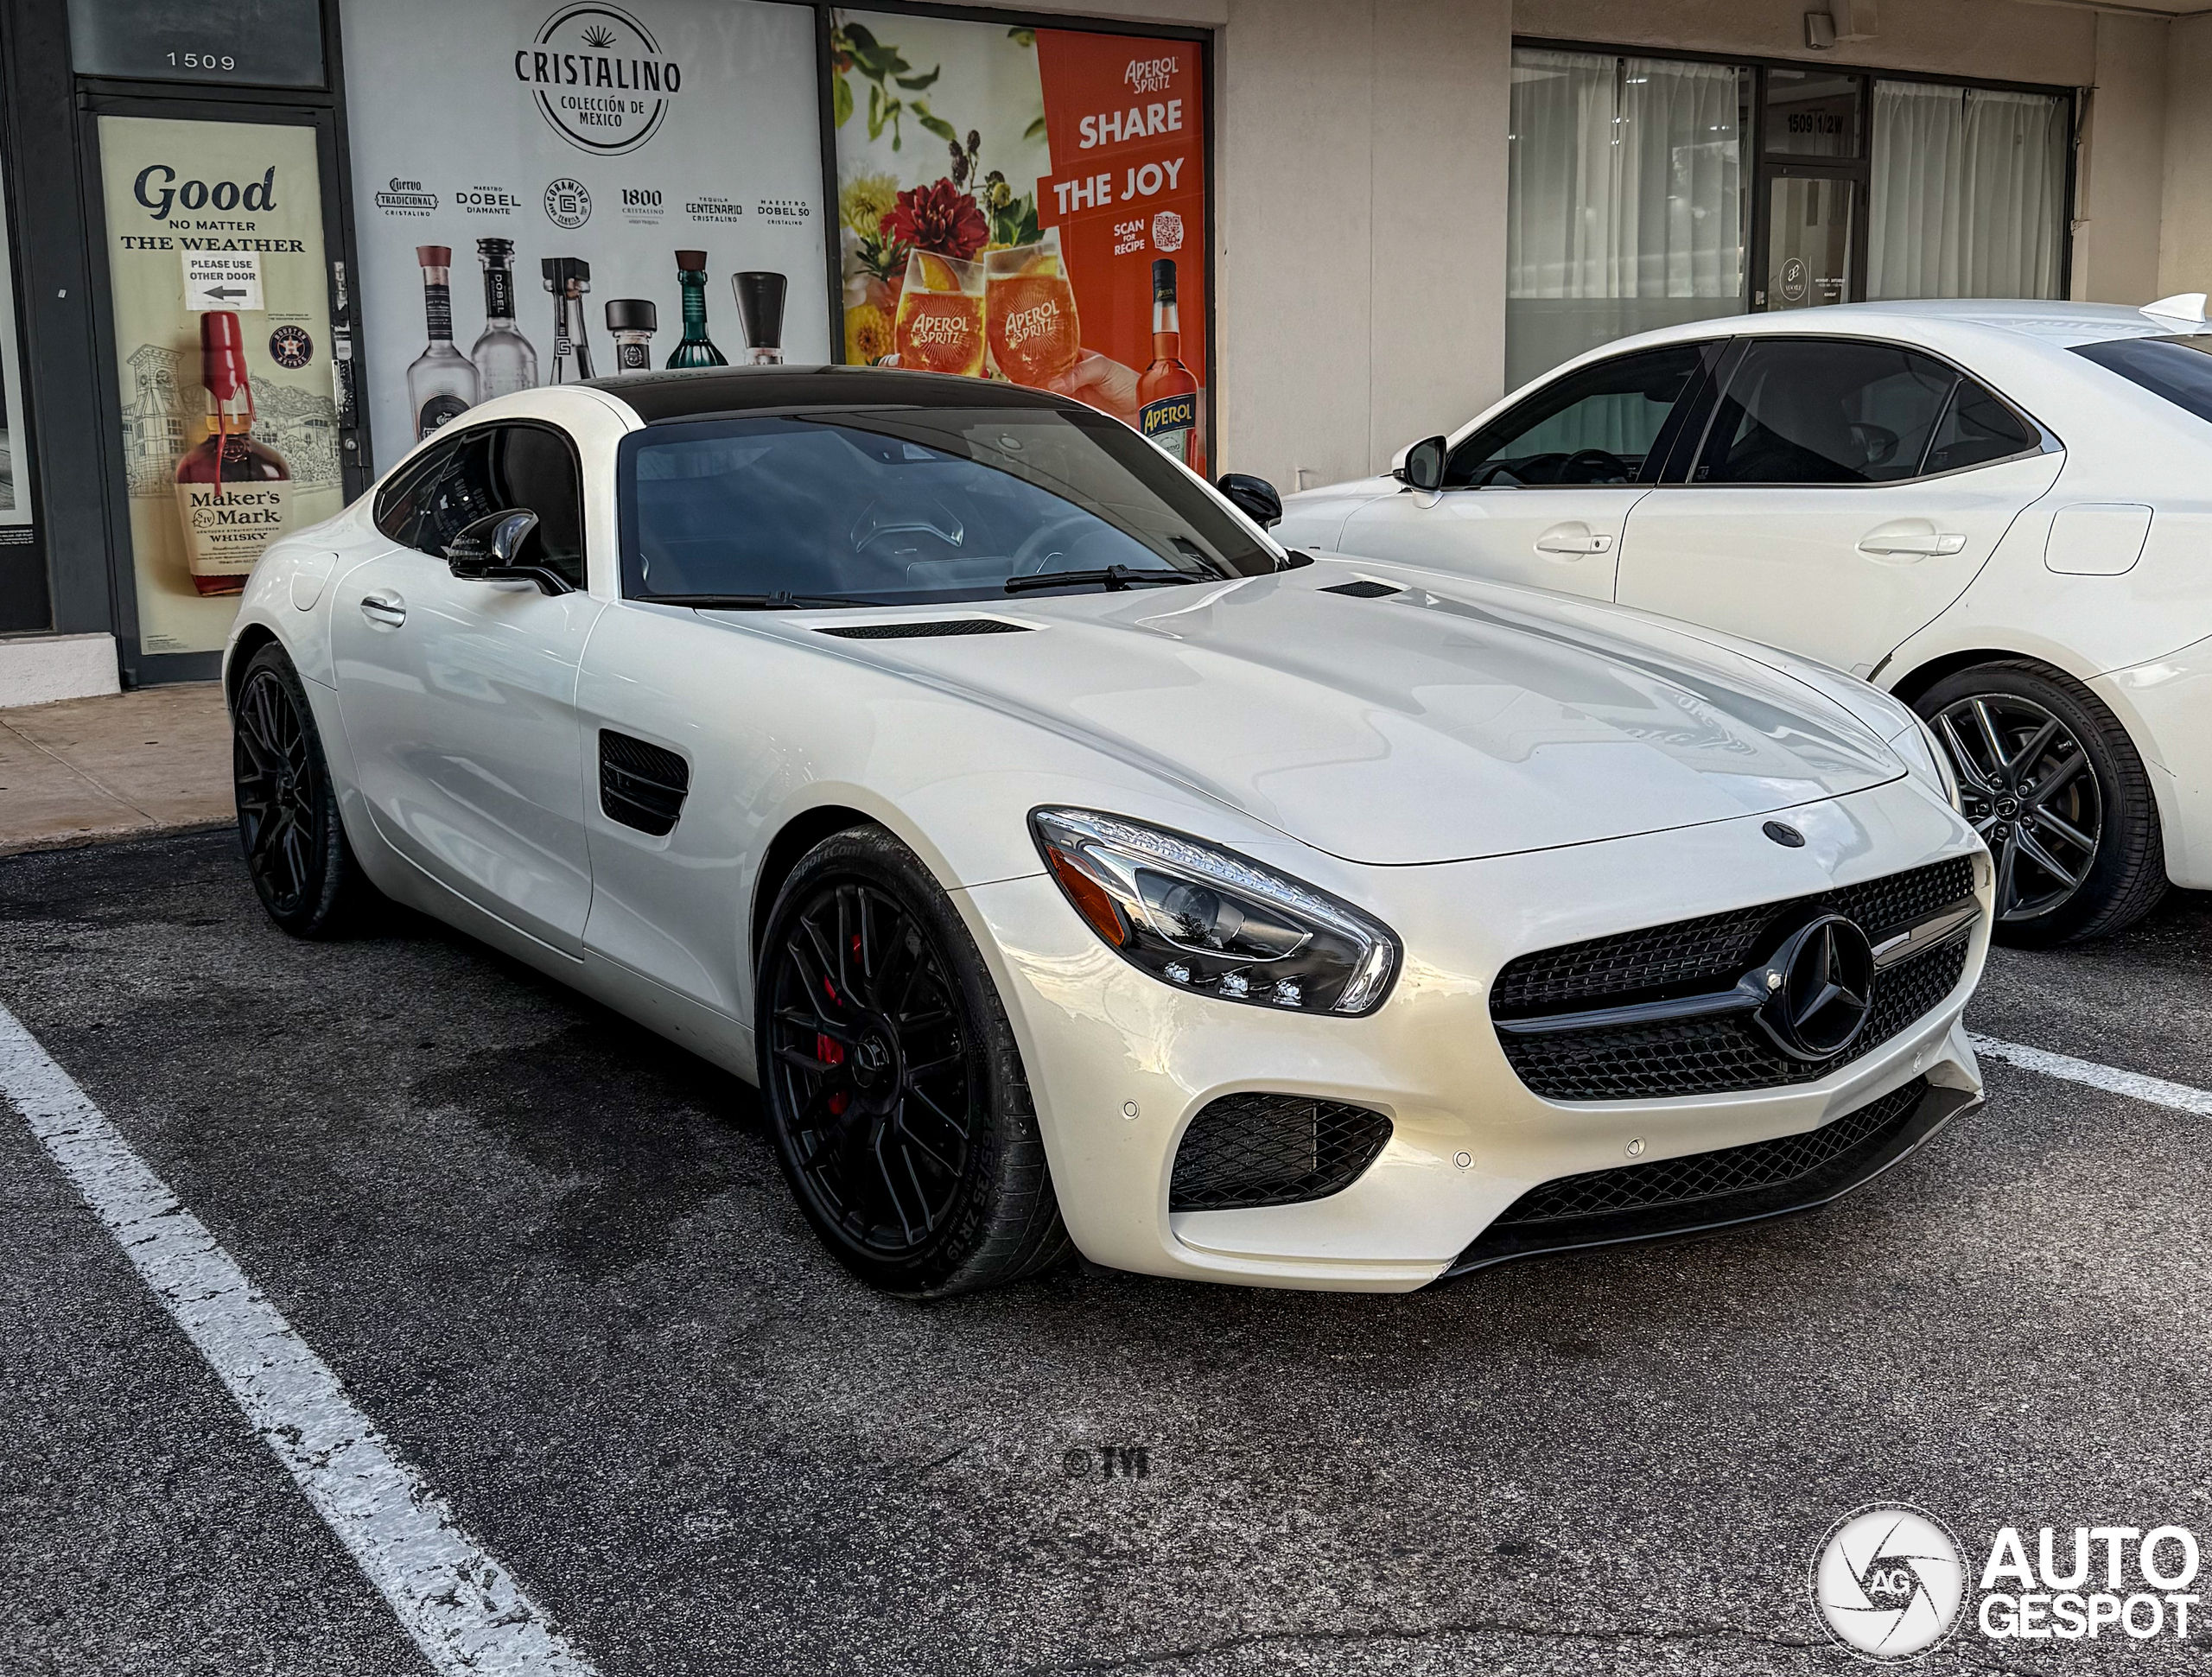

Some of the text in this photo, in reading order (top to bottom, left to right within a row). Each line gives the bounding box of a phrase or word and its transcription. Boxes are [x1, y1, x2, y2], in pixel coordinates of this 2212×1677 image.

[167, 52, 236, 71] 1509
[1124, 56, 1179, 84] APEROL
[514, 50, 681, 93] CRISTALINO
[561, 95, 645, 114] COLECCIÓN DE
[580, 112, 622, 127] MEXICO
[1079, 98, 1183, 150] SHARE
[1788, 114, 1813, 133] 1509
[134, 165, 276, 220] Good
[547, 181, 588, 203] CORAMINO
[1052, 157, 1185, 215] THE JOY
[380, 195, 432, 206] TRADICIONAL
[456, 192, 521, 206] DOBEL
[621, 188, 663, 207] 1800
[467, 206, 511, 215] DIAMANTE
[686, 203, 742, 215] CENTENARIO
[758, 206, 810, 217] DOBEL 50
[169, 219, 256, 232] NO MATTER
[1114, 219, 1144, 237] SCAN
[121, 236, 306, 253] THE WEATHER
[1123, 233, 1136, 243] FOR
[1115, 239, 1145, 256] RECIPE
[191, 260, 253, 270] PLEASE USE
[189, 271, 257, 282] OTHER DOOR
[495, 274, 505, 314] DOBEL
[911, 313, 969, 333] APEROL
[1005, 299, 1060, 335] APEROL
[274, 327, 307, 340] HOUSTON
[277, 355, 308, 367] ASTROS
[1144, 403, 1192, 435] APEROL
[189, 490, 281, 508] Maker's
[216, 509, 281, 525] Mark
[209, 532, 269, 543] WHISKY
